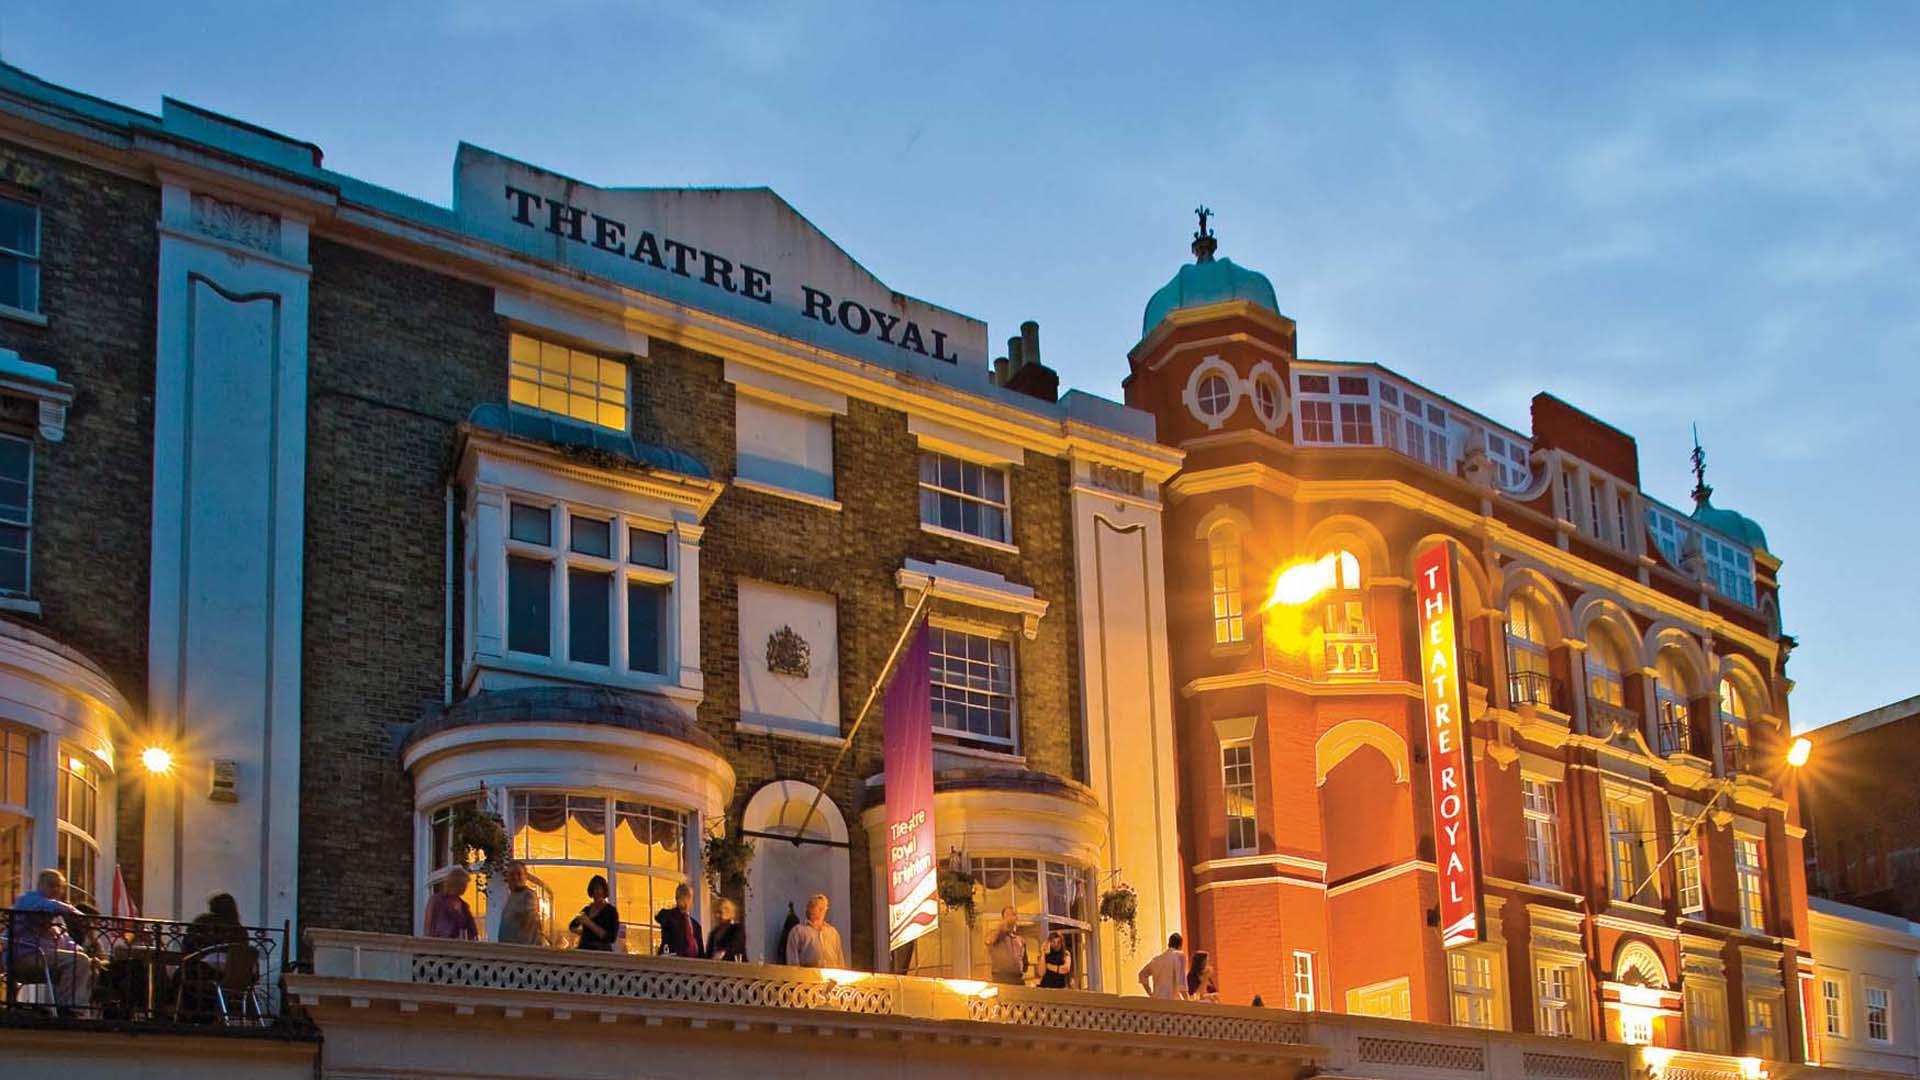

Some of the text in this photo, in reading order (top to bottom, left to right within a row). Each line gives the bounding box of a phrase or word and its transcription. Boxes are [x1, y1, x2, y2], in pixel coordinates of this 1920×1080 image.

[505, 186, 959, 366] THEATRE ROYAL
[1424, 565, 1464, 903] THEATRE ROYAL
